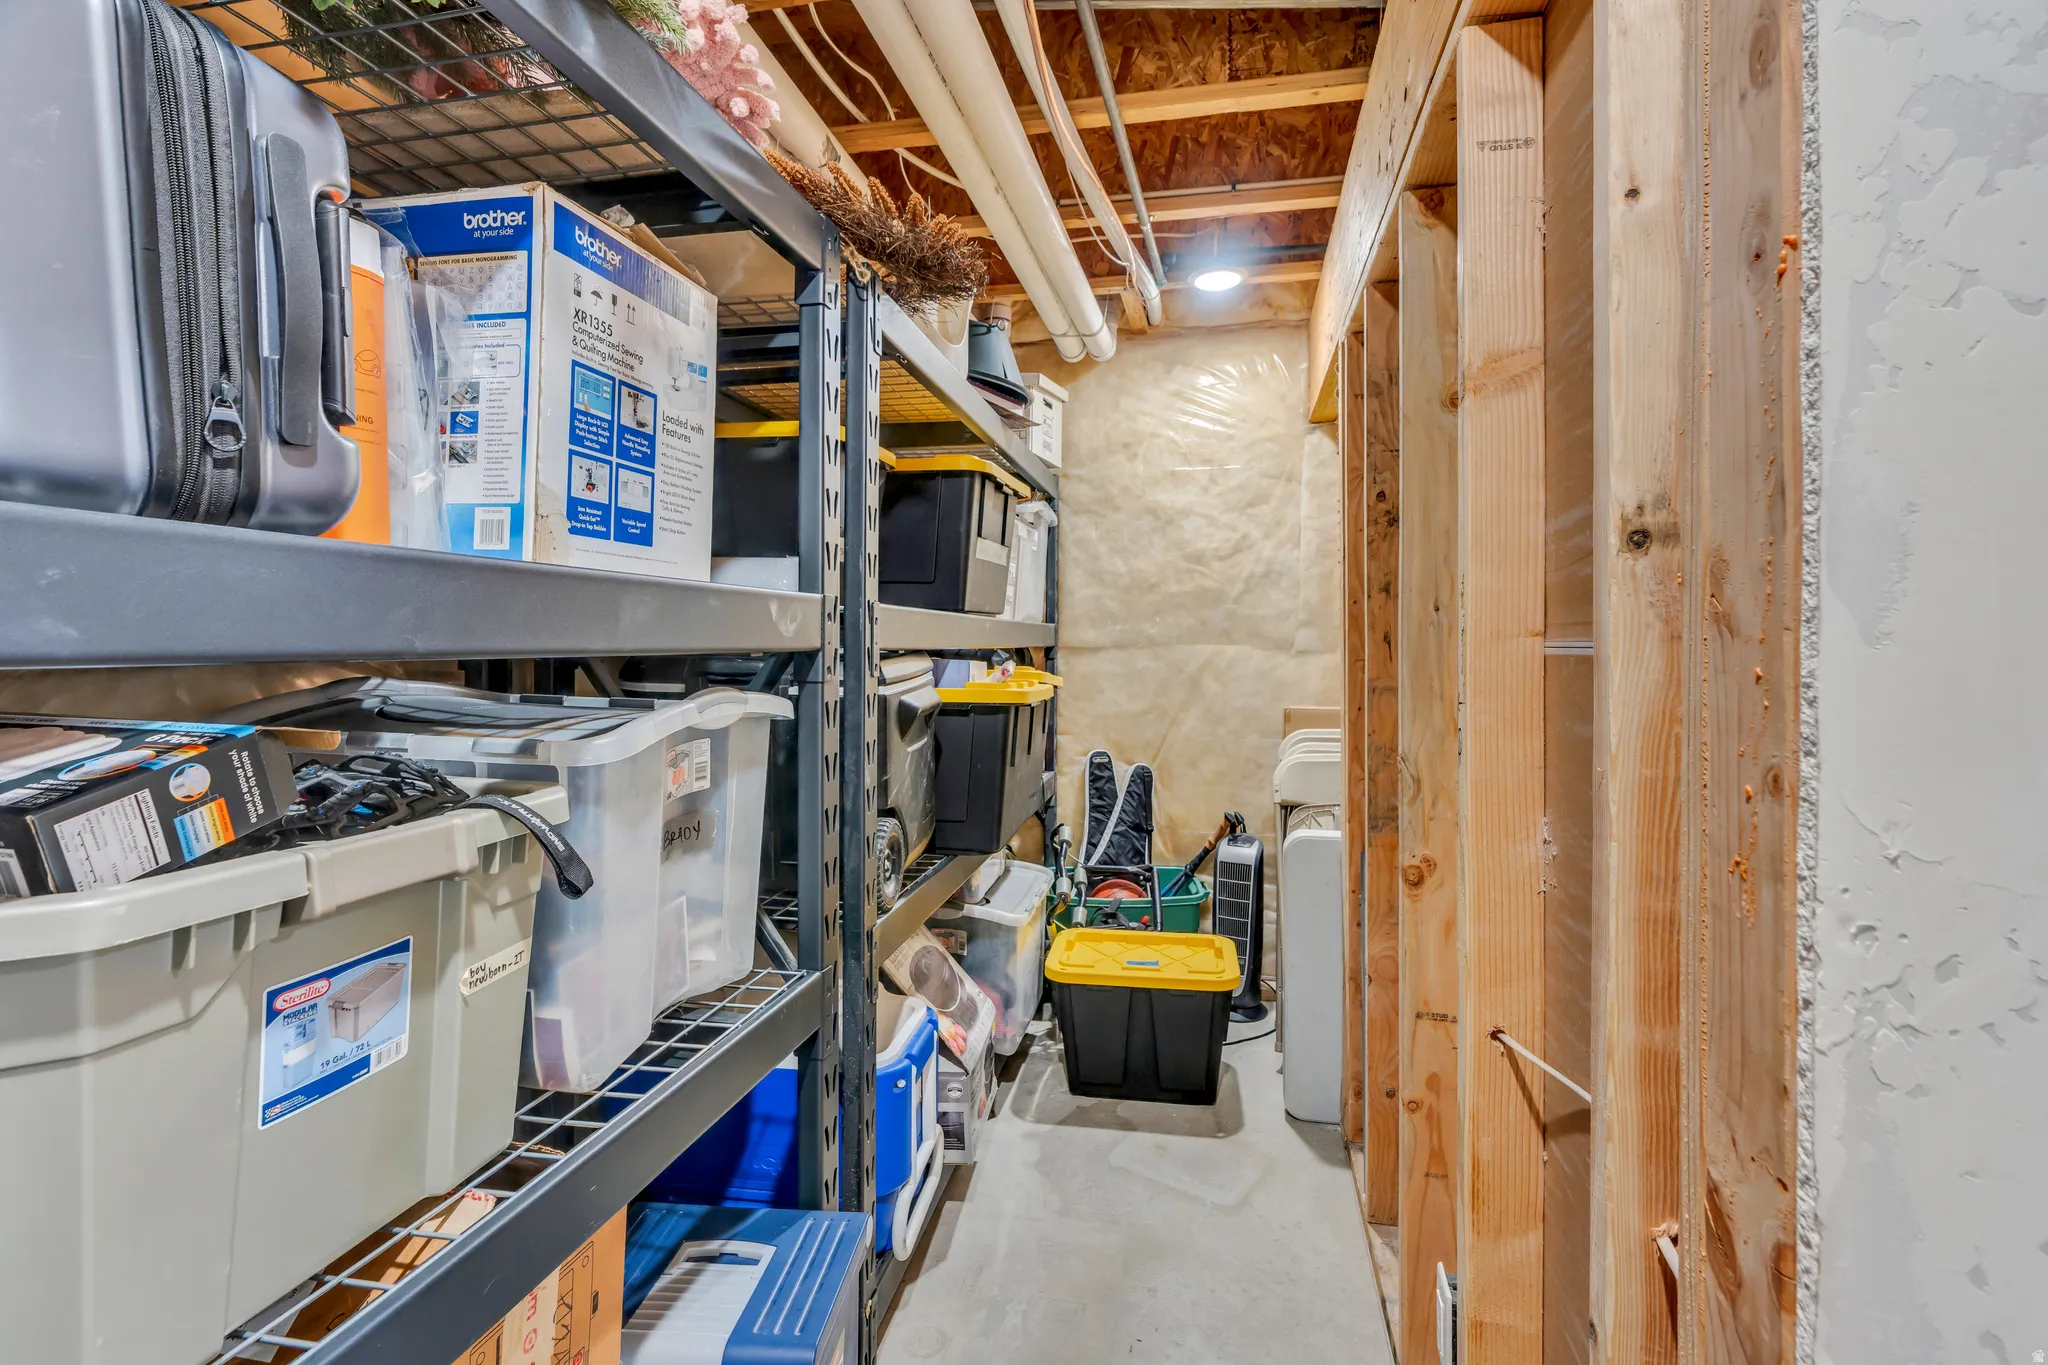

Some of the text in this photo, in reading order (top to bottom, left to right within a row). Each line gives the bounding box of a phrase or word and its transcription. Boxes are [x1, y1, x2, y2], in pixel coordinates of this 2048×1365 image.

[463, 210, 526, 229] brother
[473, 227, 514, 239] at your side
[575, 225, 622, 267] brother
[582, 249, 614, 272] at your side
[476, 321, 507, 329] INCLUDED
[573, 307, 613, 337] XR1355
[572, 321, 644, 366] Computerized Sewing
[572, 335, 635, 372] & Quilting Machine
[661, 424, 691, 443] Features
[662, 410, 704, 436] Loaded with
[227, 748, 257, 824] your shade of white
[240, 750, 266, 816] Rotate to choose
[139, 790, 154, 821] Lighting
[149, 819, 160, 840] Facts
[663, 820, 701, 851] BRADY
[470, 963, 487, 979] boy
[280, 986, 324, 1008] Sterilite
[283, 1003, 318, 1021] MODULAR
[320, 1060, 331, 1070] 19
[332, 1052, 349, 1065] Gal.
[355, 1043, 365, 1053] 72
